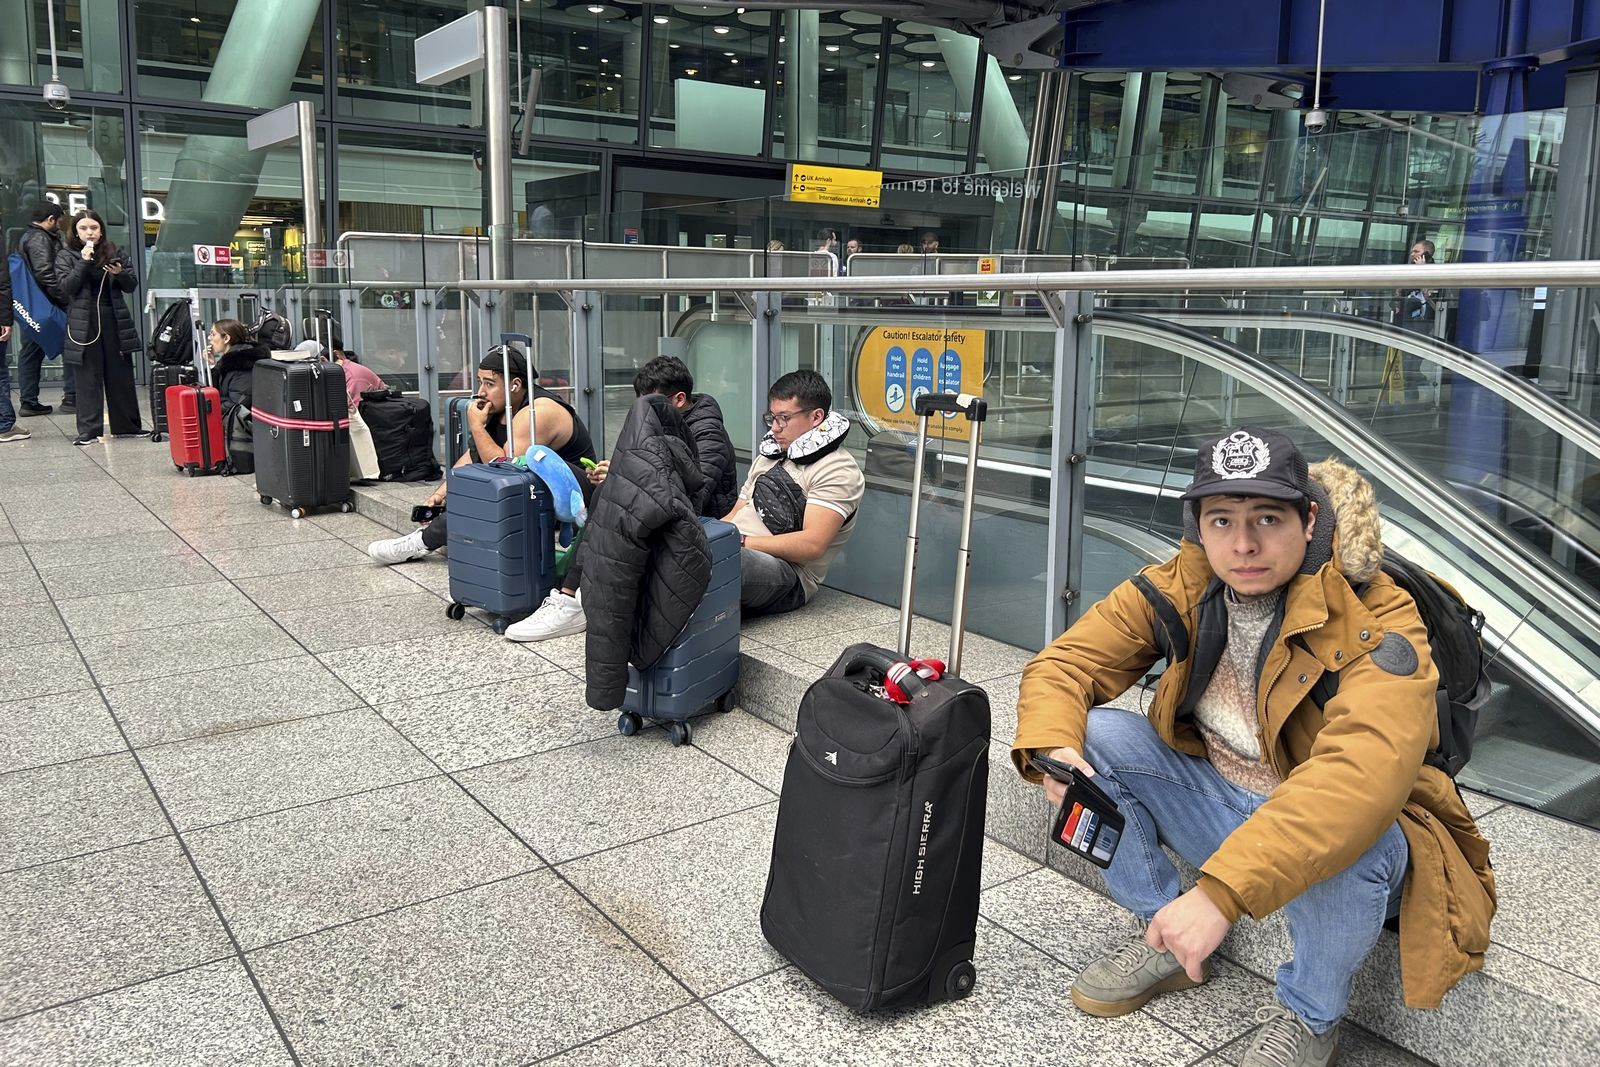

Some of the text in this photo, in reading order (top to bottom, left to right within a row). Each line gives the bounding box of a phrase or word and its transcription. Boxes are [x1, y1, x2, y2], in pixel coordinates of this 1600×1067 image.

[883, 330, 966, 344] Caution! Escalator safety
[913, 859, 924, 894] HIGH
